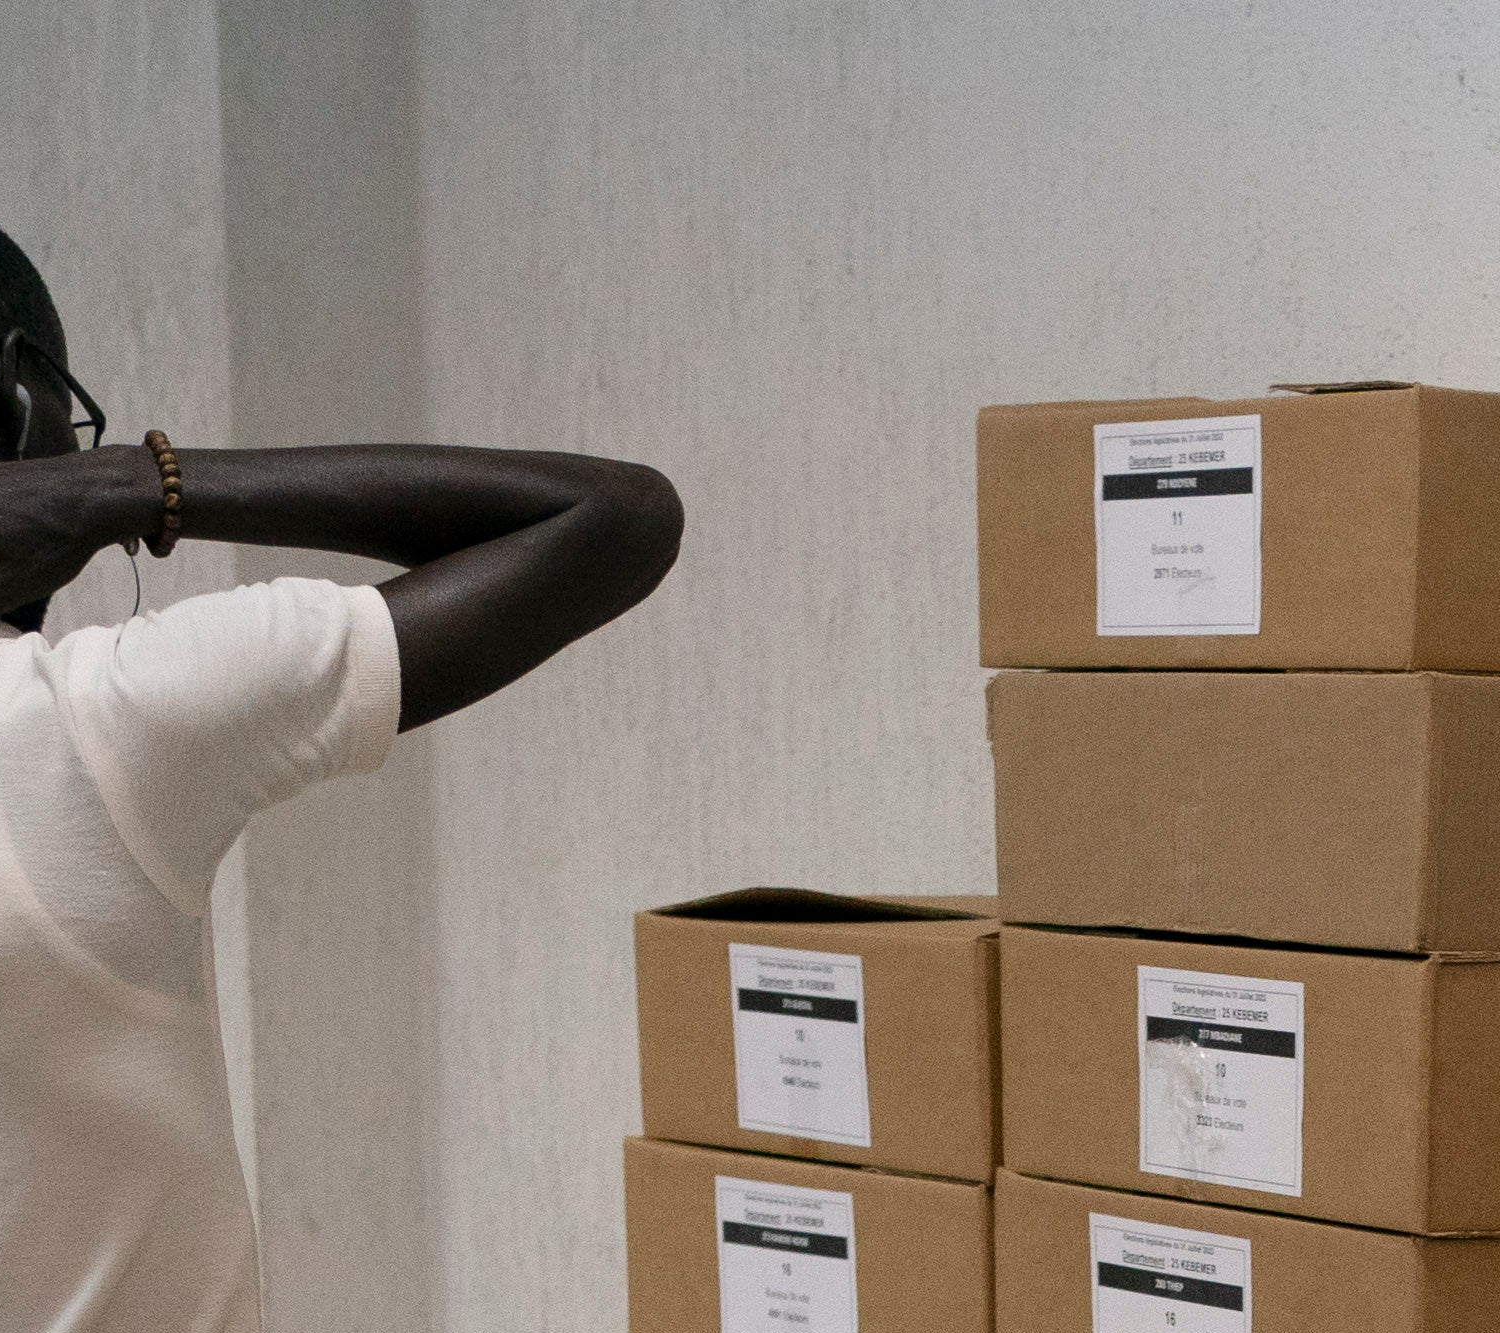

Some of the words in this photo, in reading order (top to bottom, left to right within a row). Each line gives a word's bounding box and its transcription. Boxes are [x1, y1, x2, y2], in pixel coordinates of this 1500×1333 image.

[1172, 511, 1183, 525] 11
[1222, 1007, 1230, 1018] 25
[1232, 1008, 1269, 1023] KEBEMER
[1215, 1063, 1226, 1077] 10
[1181, 1259, 1217, 1275] KEBEMER
[1165, 1311, 1176, 1326] 16
